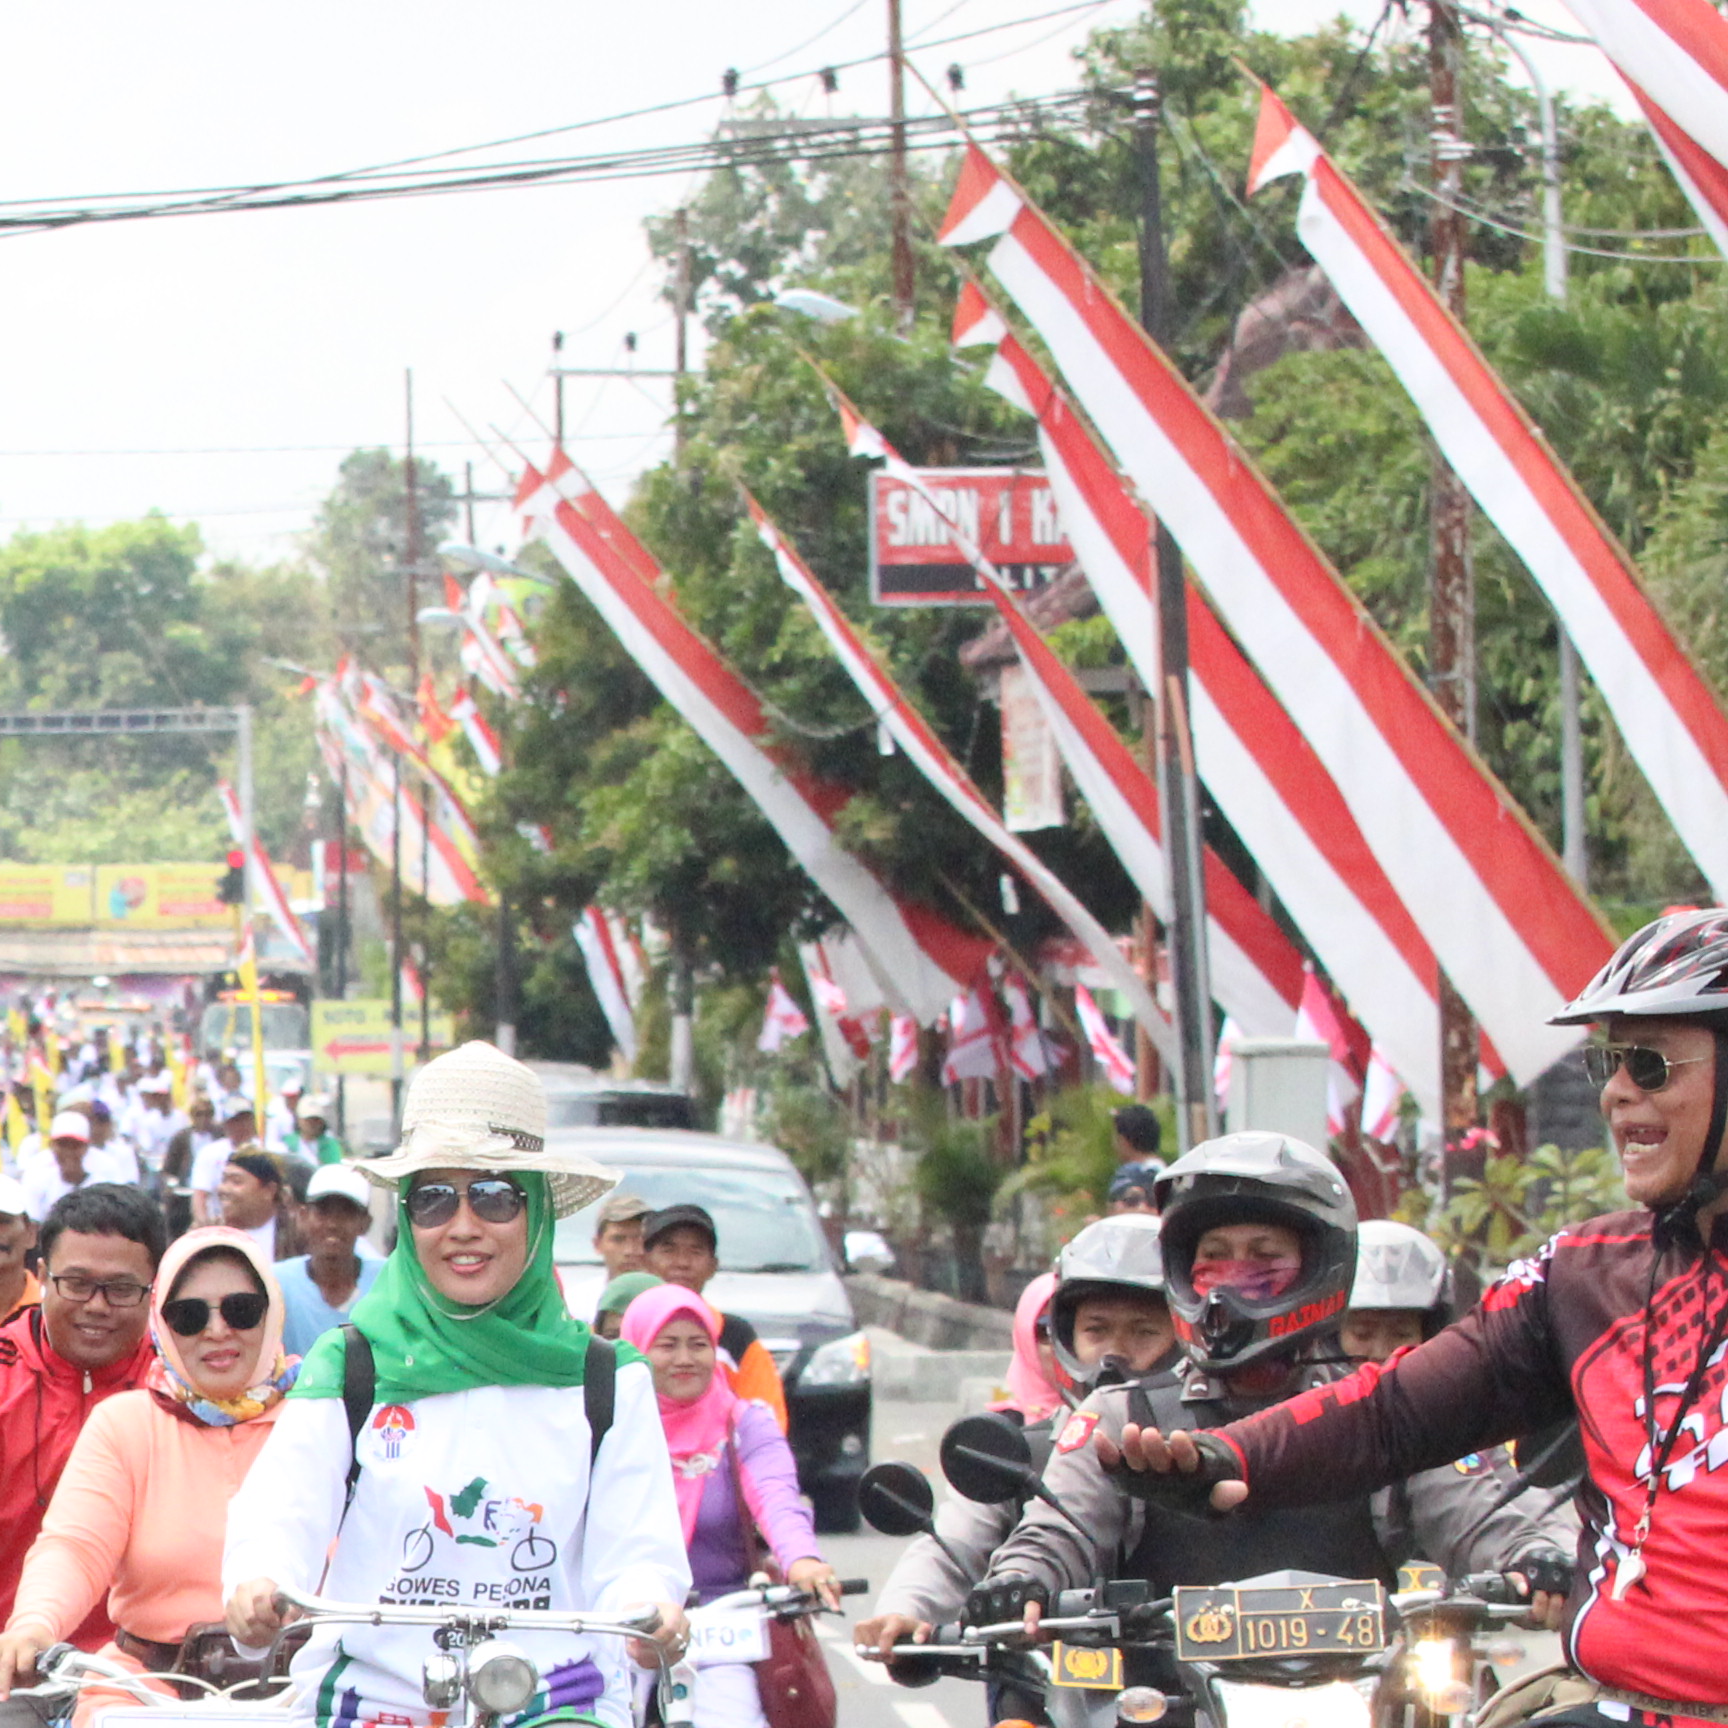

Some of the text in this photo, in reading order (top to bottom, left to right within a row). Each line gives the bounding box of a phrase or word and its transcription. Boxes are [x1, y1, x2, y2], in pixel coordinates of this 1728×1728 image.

[1299, 1587, 1315, 1610] X
[1246, 1617, 1309, 1651] 1019
[1336, 1615, 1374, 1647] 48
